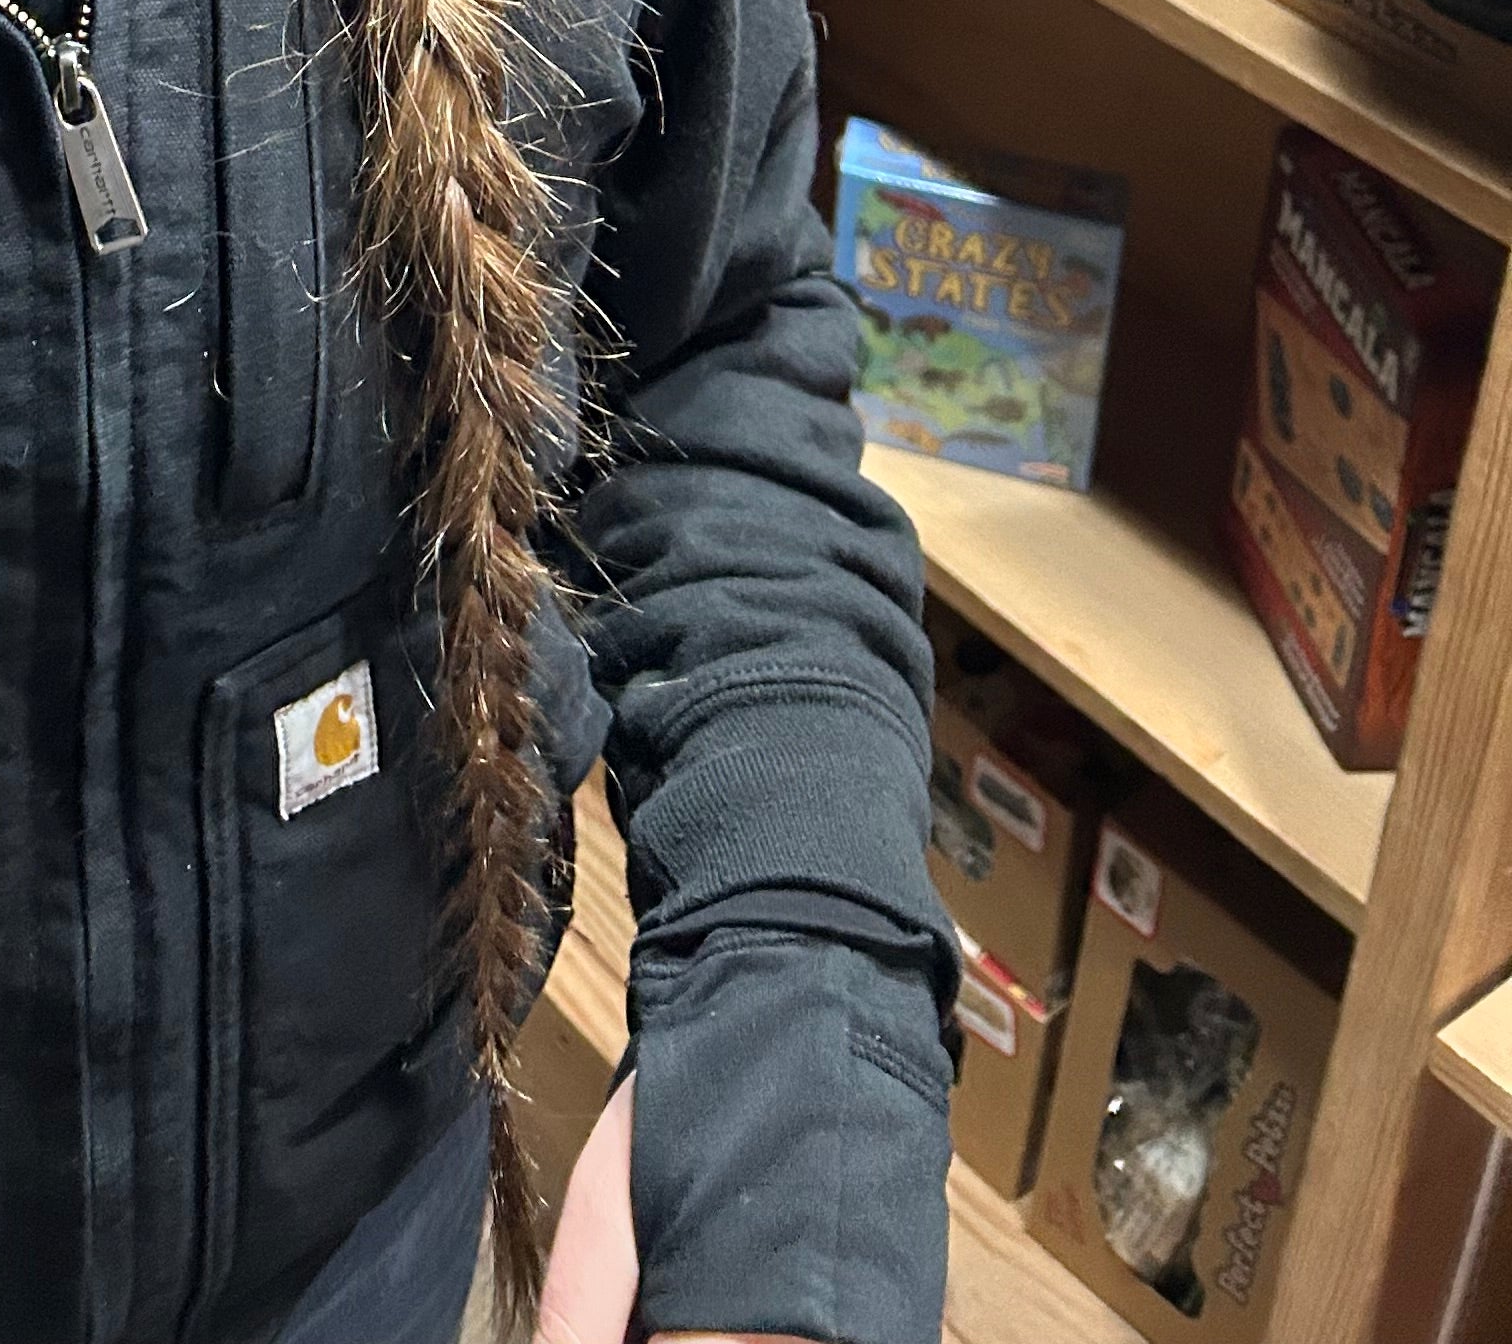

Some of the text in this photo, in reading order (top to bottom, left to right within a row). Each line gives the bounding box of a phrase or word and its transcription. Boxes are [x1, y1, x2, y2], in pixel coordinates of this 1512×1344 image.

[79, 126, 117, 217] carhartt
[861, 245, 1075, 329] STATES
[893, 216, 1057, 282] CRAZY
